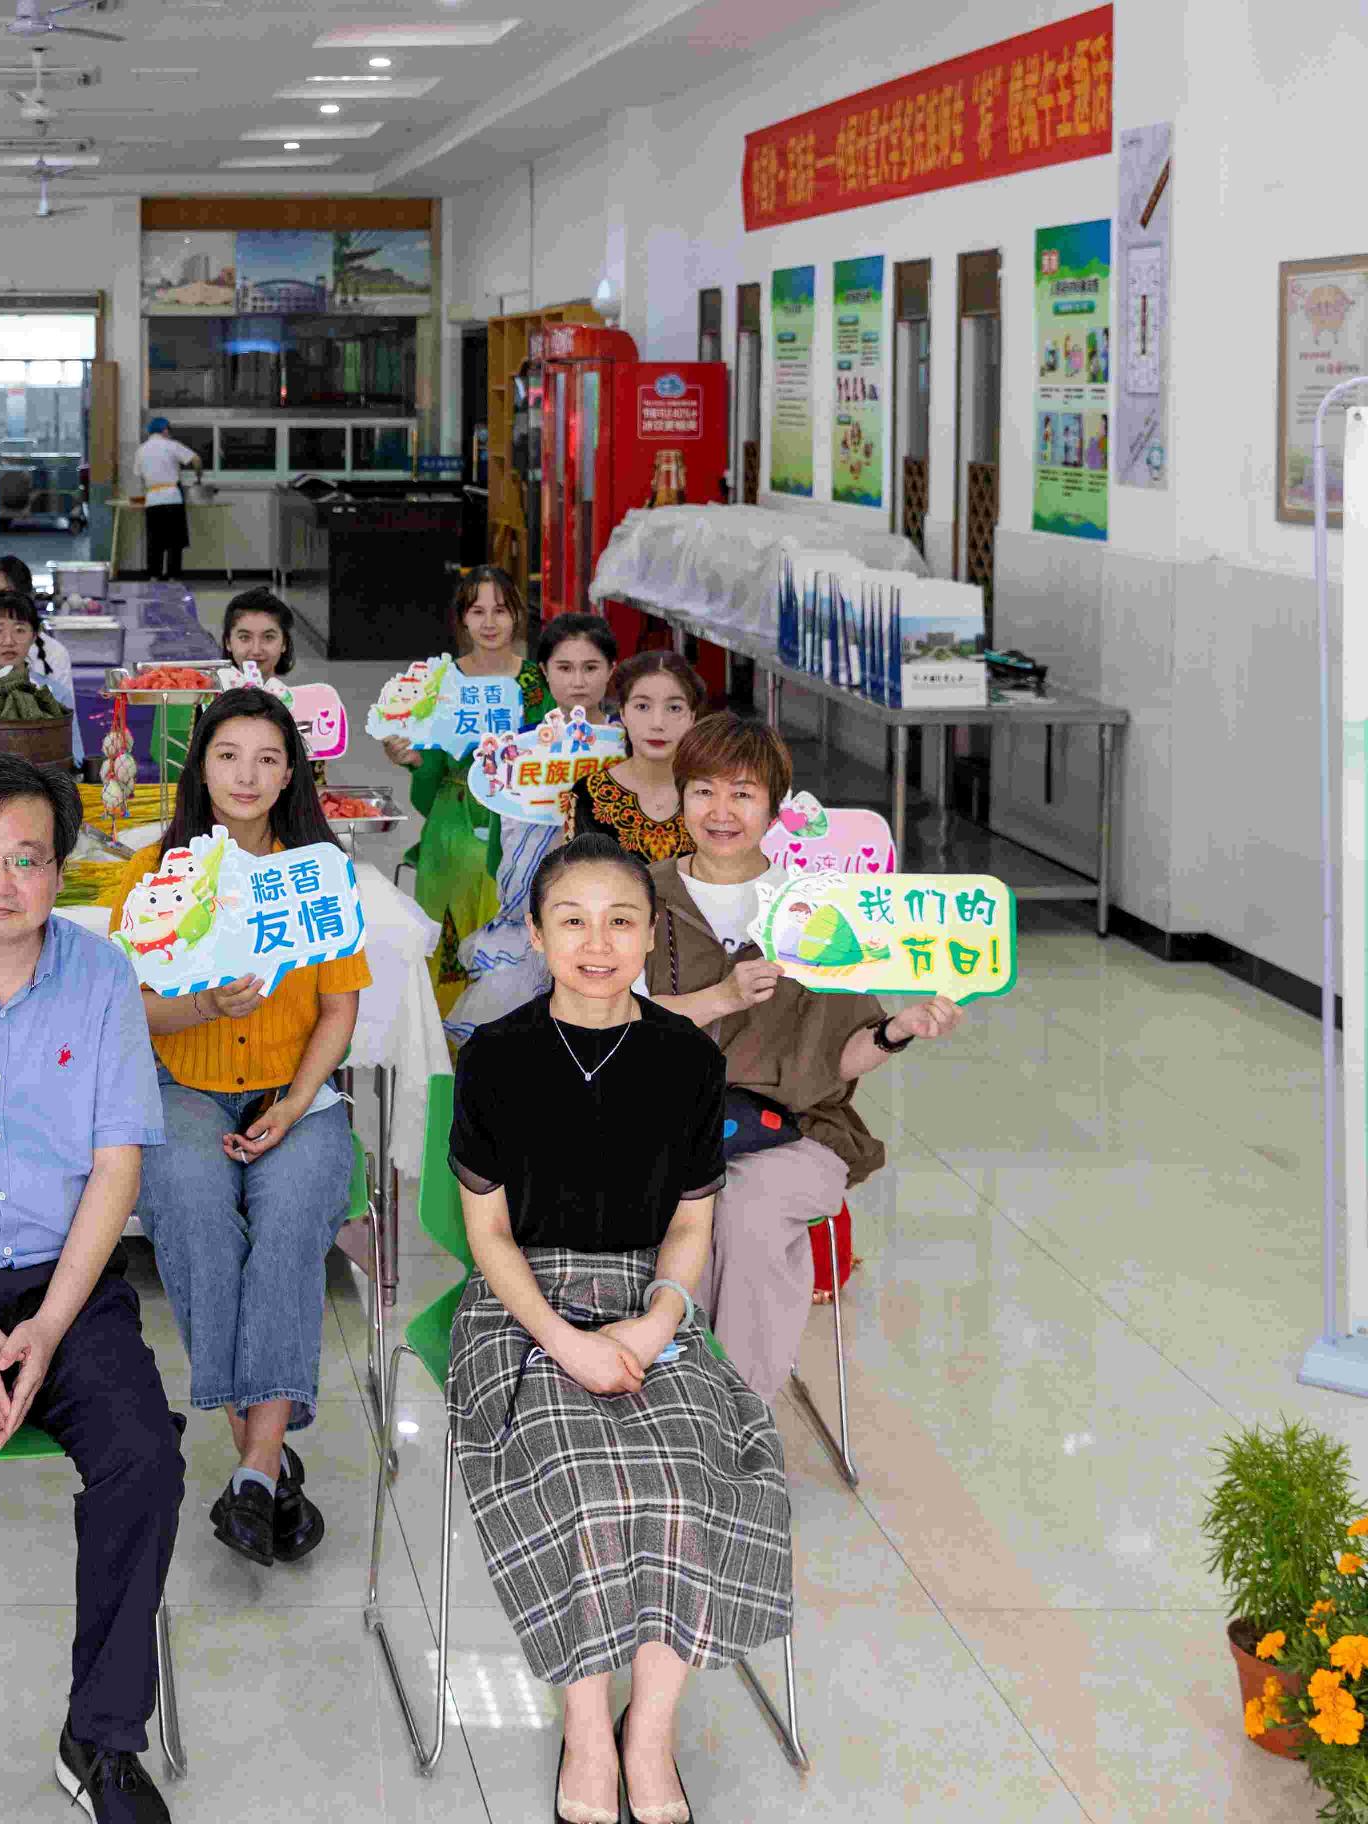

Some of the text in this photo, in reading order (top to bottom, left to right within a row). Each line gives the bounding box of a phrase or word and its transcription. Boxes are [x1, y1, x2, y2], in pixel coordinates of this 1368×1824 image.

[460, 684, 503, 705] 粽香
[454, 708, 512, 736] 友情
[250, 859, 321, 905] 粽香
[246, 895, 345, 955] 友情
[858, 886, 996, 926] 我们的
